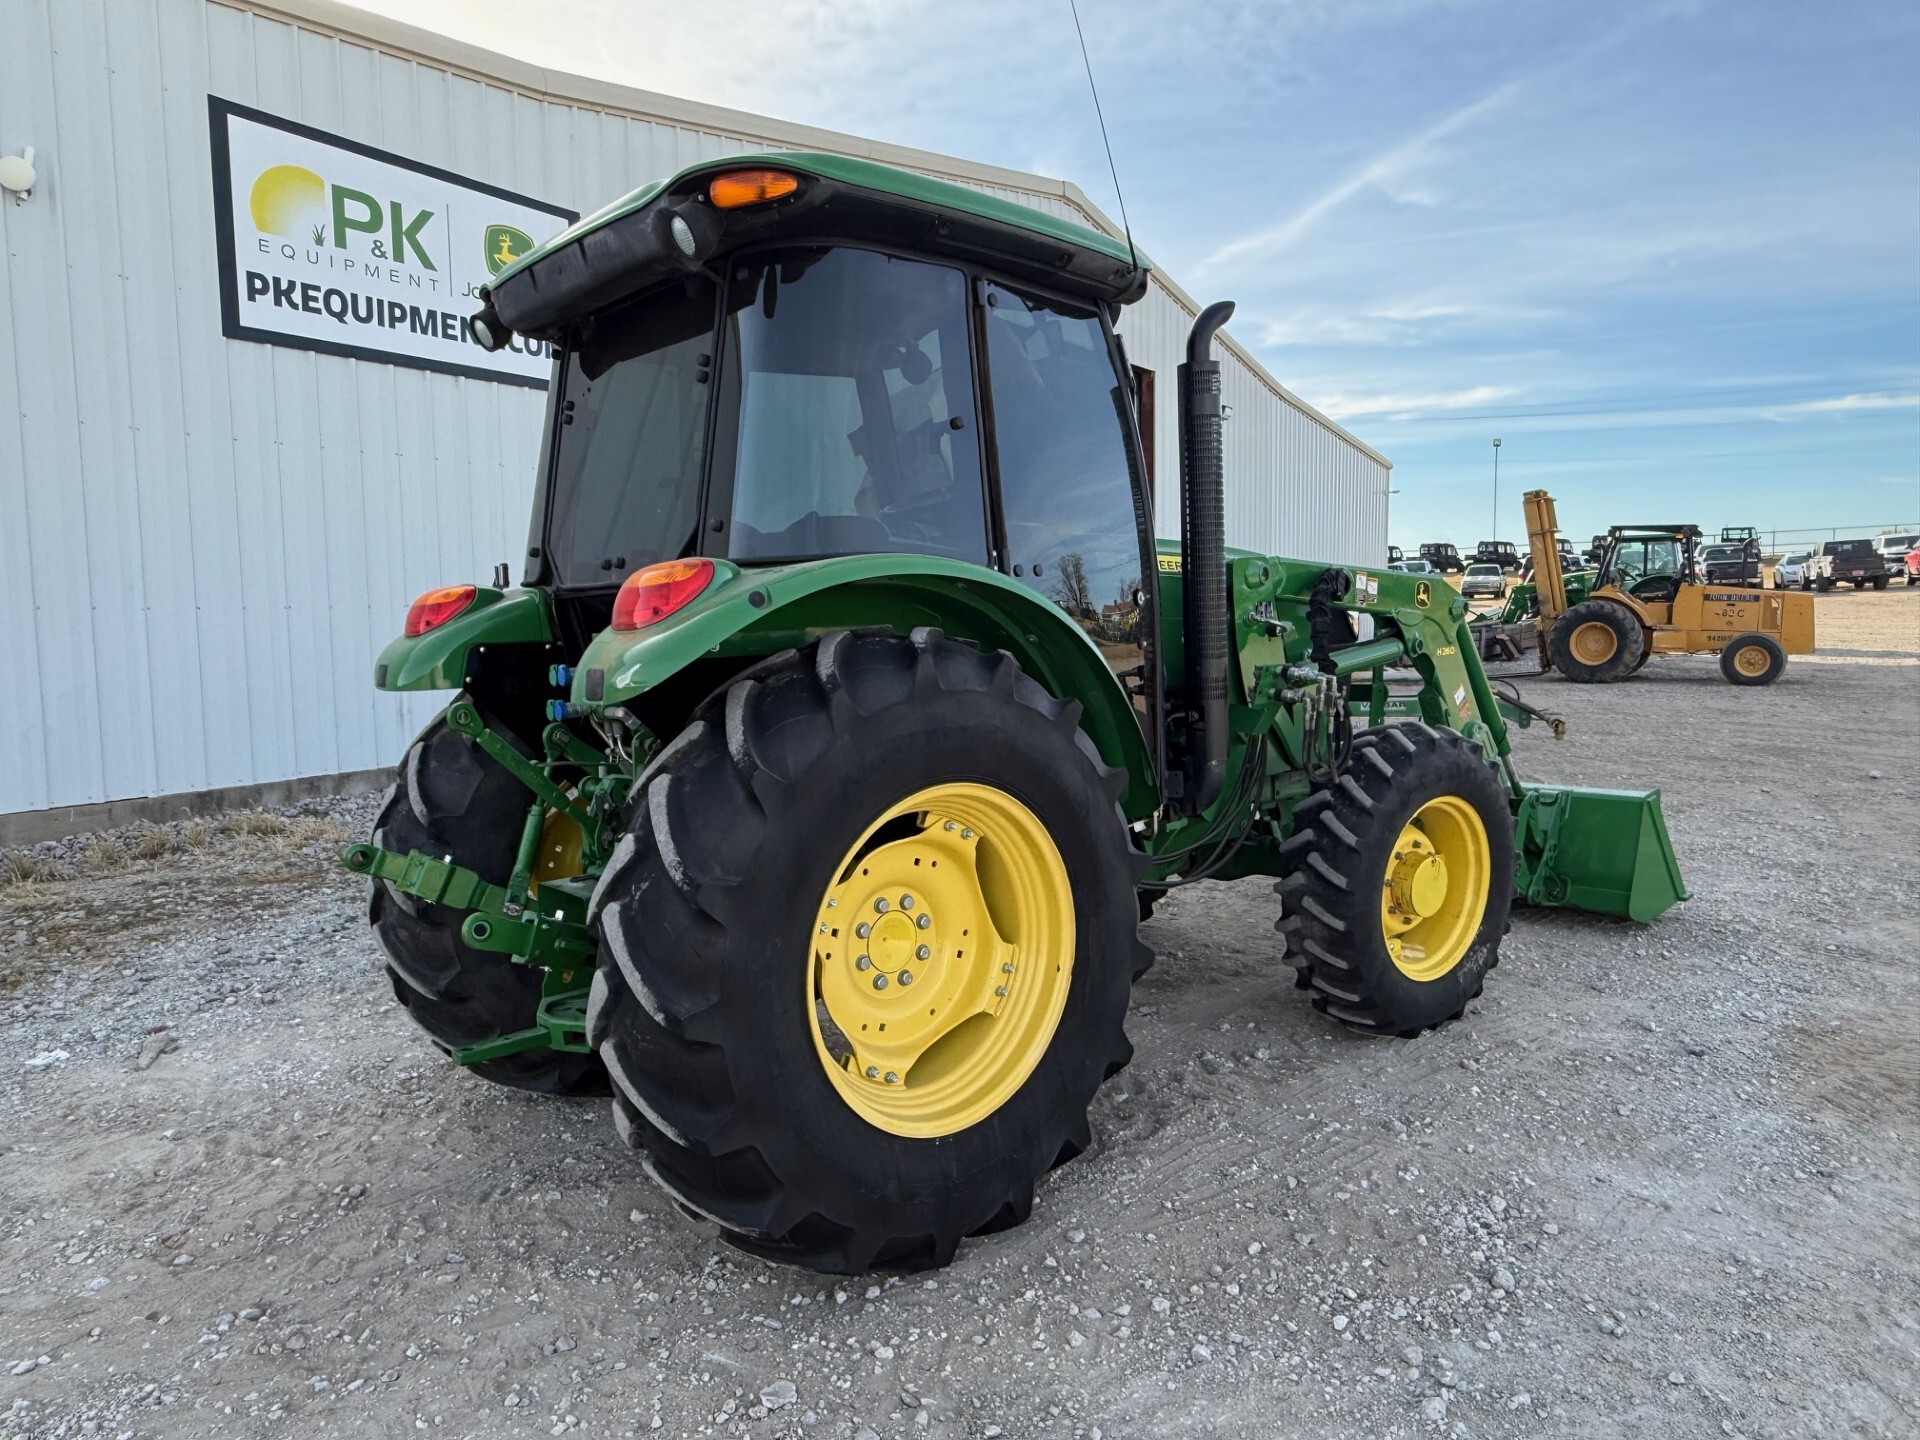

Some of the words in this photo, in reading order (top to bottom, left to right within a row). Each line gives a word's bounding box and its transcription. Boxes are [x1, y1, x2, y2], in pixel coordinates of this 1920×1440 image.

[258, 238, 440, 292] EQUIPMENT
[331, 183, 438, 272] P&K
[245, 270, 551, 360] PKEQUIPMENCO
